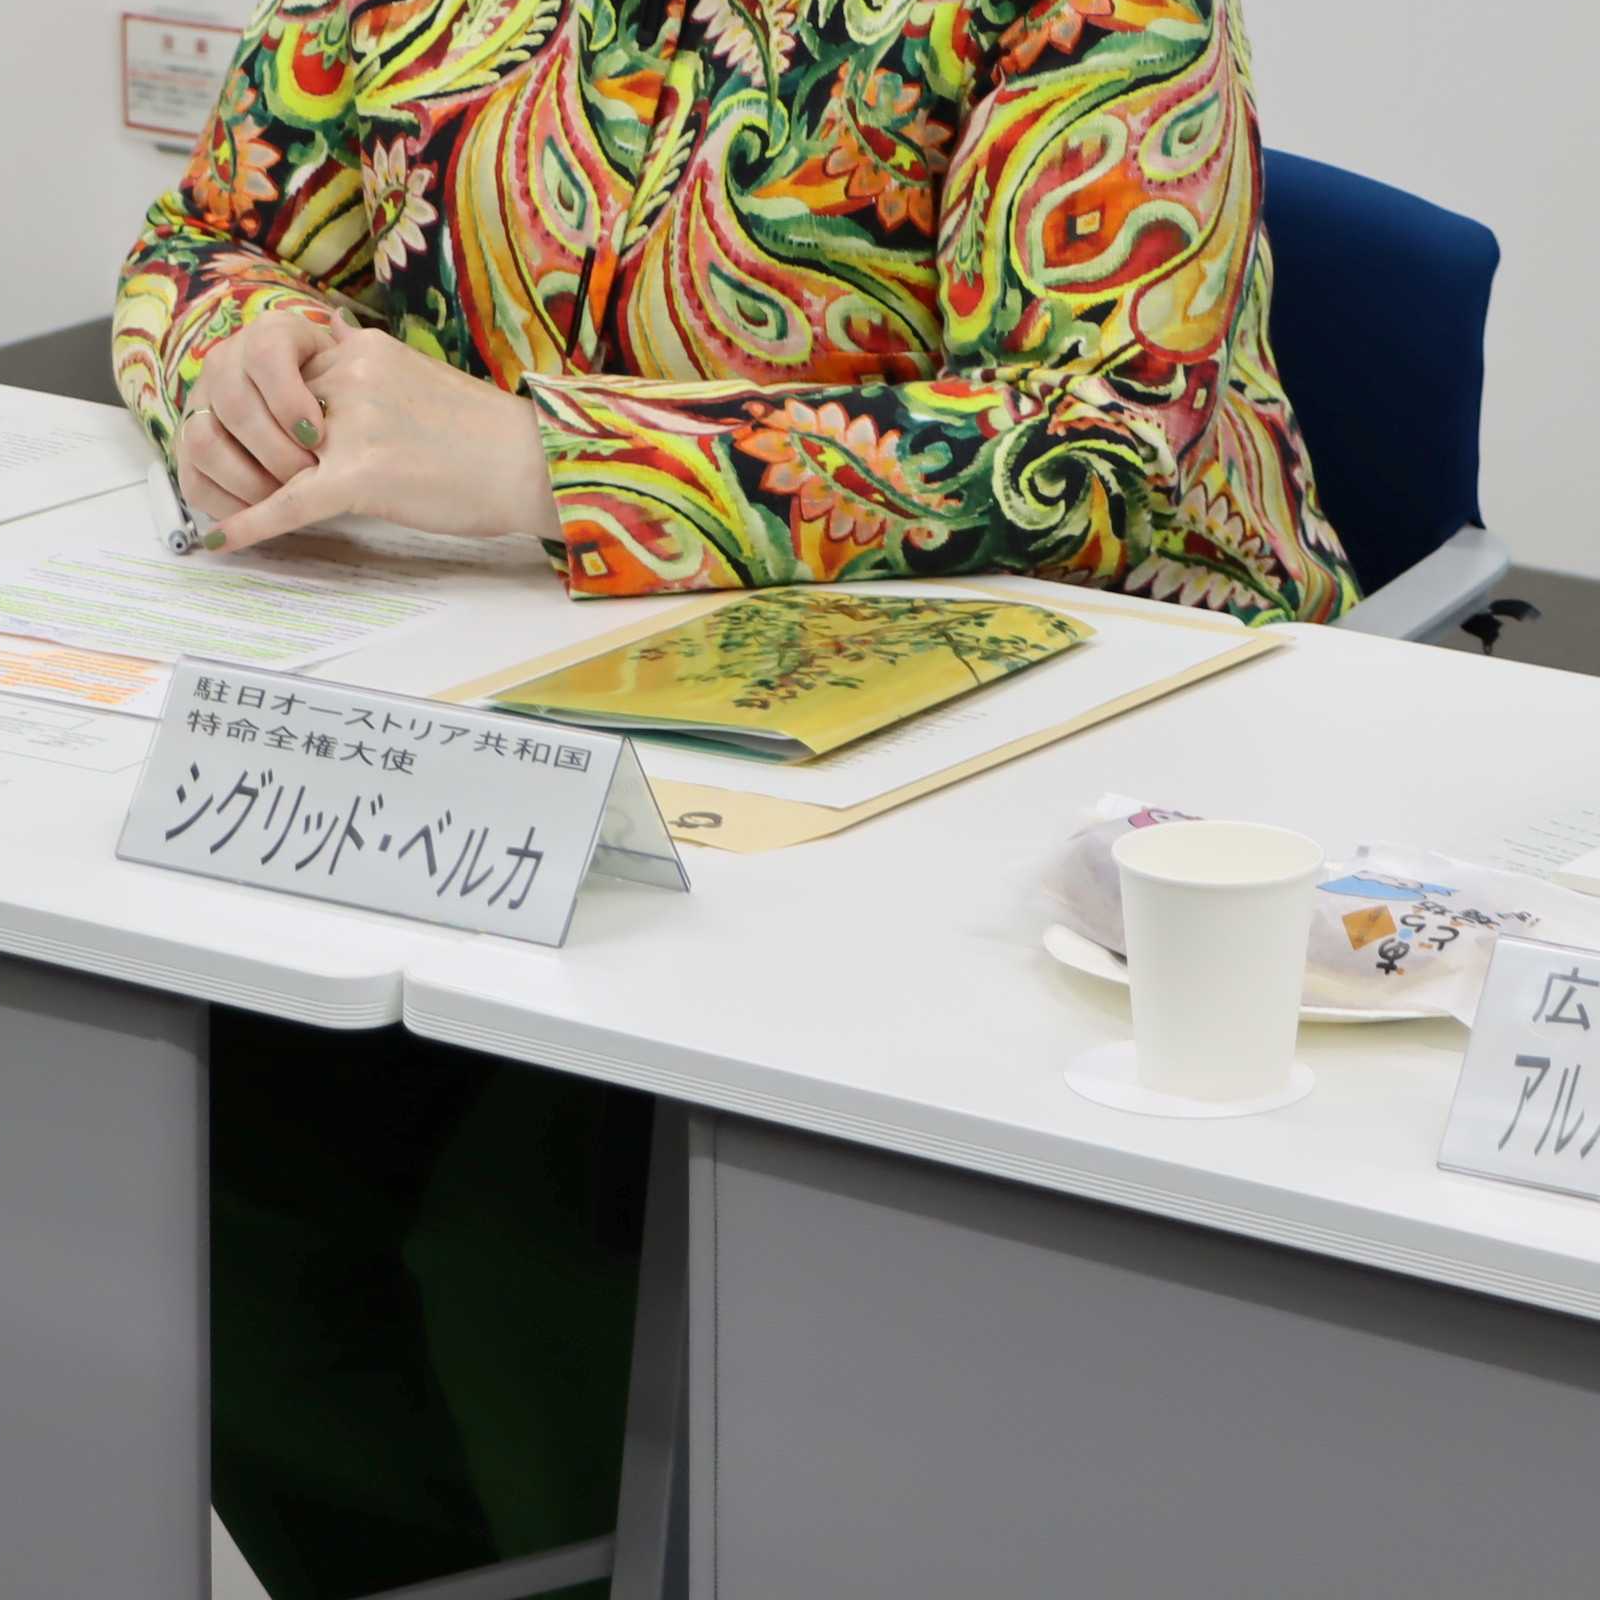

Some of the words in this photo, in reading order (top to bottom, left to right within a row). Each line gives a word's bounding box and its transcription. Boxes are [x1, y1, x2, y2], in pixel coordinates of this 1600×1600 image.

[186, 710, 418, 776] 特命全権大使
[192, 675, 592, 773] 駐日オーストリア共和国
[164, 761, 545, 911] シグリッド・ベルカ
